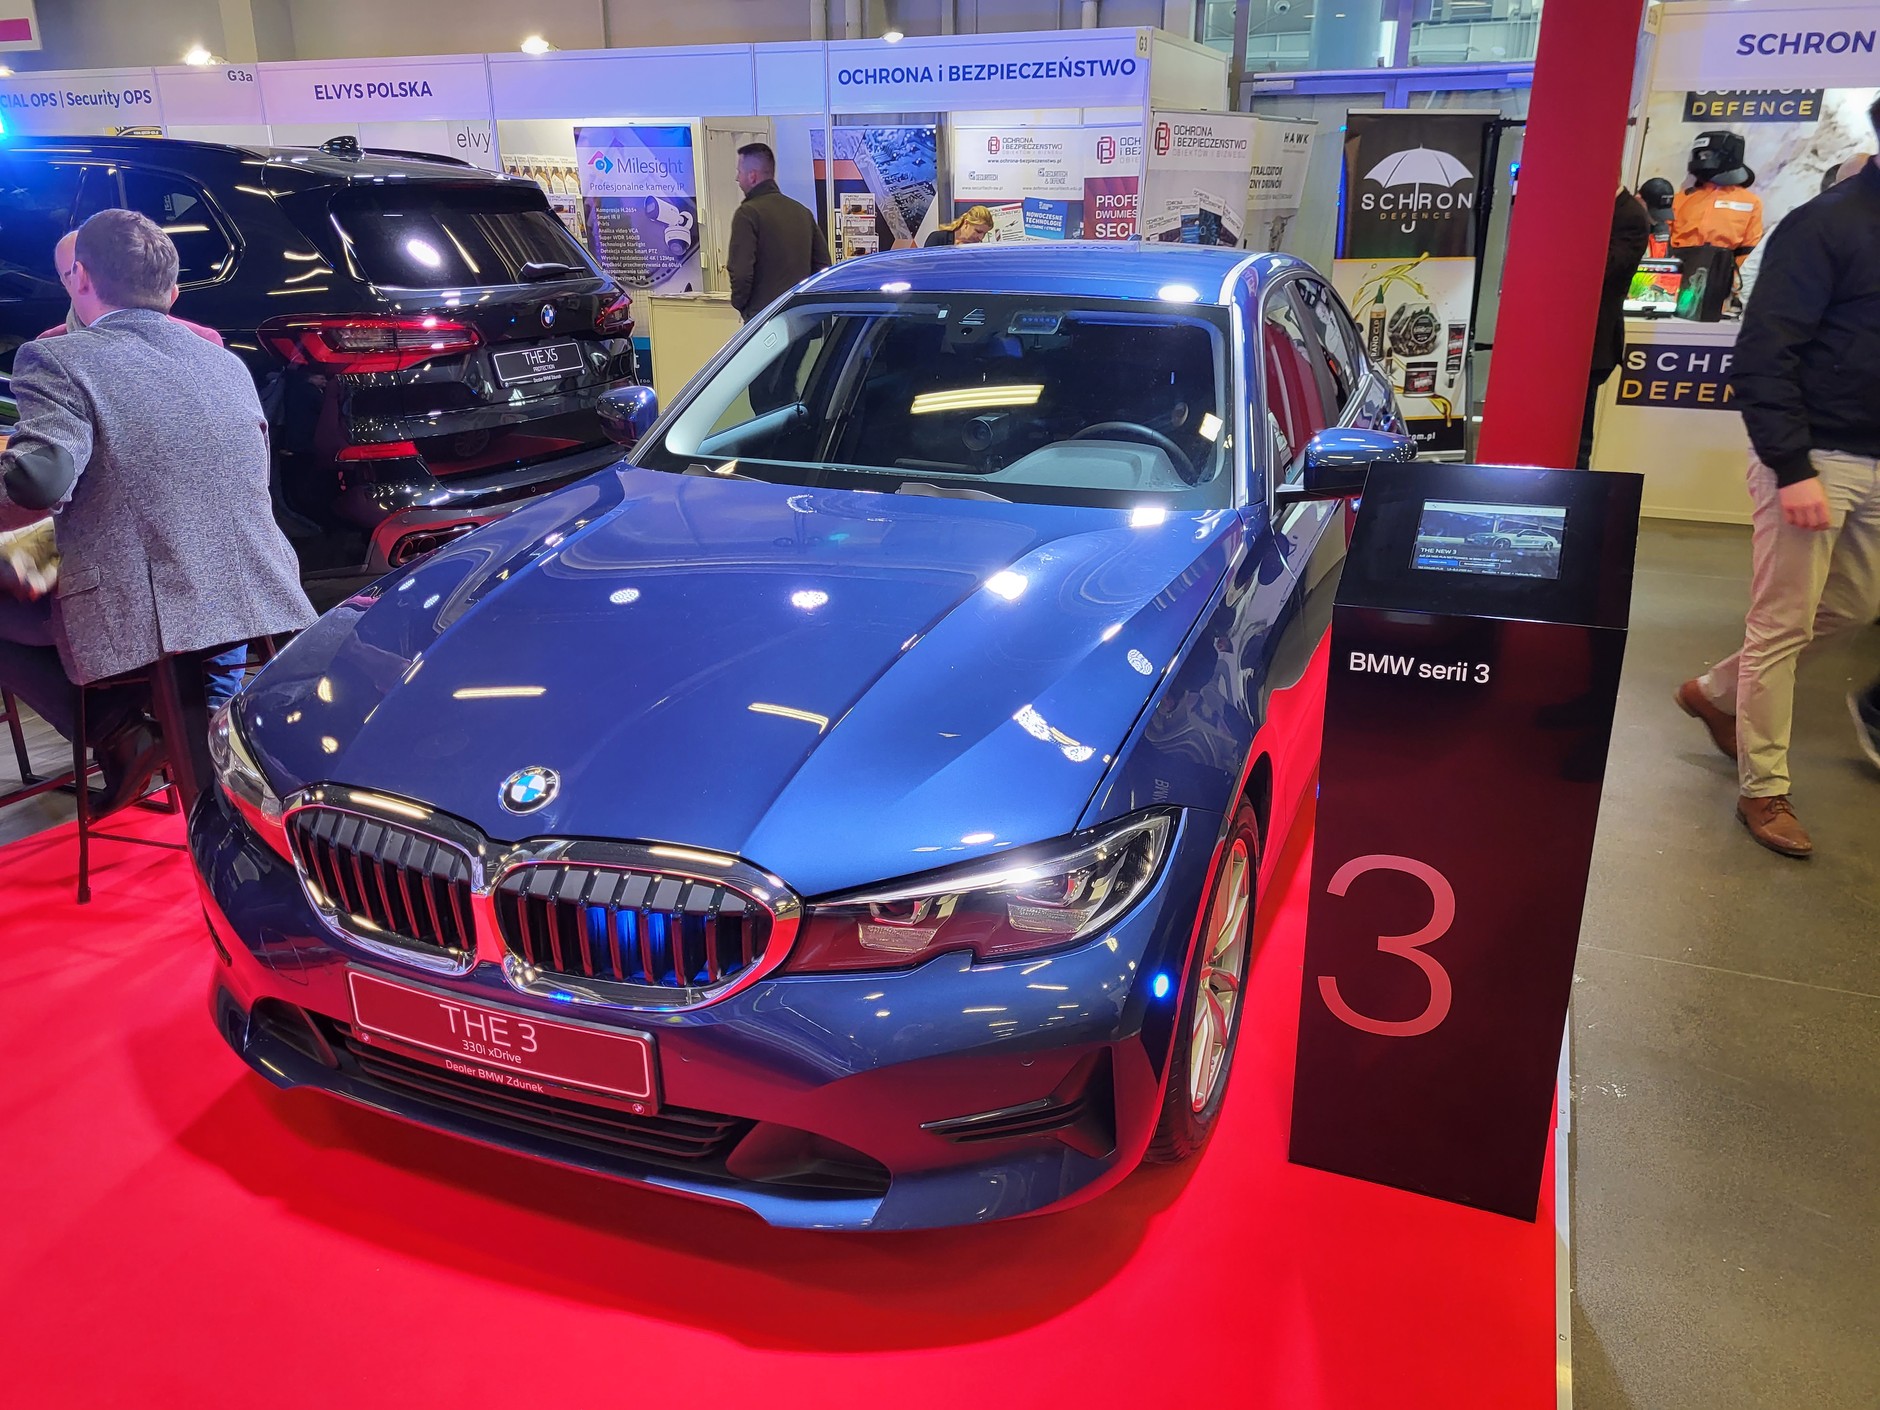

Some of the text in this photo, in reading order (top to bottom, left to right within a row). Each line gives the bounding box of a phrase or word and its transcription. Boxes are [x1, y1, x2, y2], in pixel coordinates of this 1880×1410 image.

[1138, 35, 1148, 51] G3
[1736, 30, 1876, 56] SCHRON
[227, 70, 253, 82] G3a
[837, 56, 1136, 86] OCHRONA i BEZPIECZEŃSTWO
[30, 92, 58, 107] OPS
[66, 89, 121, 109] Security
[123, 89, 152, 105] OPS
[314, 81, 433, 100] ELVYS POLSKA
[1691, 100, 1813, 116] DEFENCE
[1173, 124, 1212, 137] OCHRONA
[1283, 132, 1310, 145] HAWK
[617, 157, 684, 178] Milesight
[590, 182, 685, 192] Profesjonalne kamery IP
[1361, 193, 1473, 210] SCHRON
[1026, 211, 1063, 221] NOWOCZESNE
[1026, 217, 1062, 227] TECHNOLOGIE
[1380, 212, 1451, 220] DEFENCE
[522, 348, 559, 365] THE X5
[1349, 651, 1490, 684] BMW serii 3
[1317, 854, 1457, 1037] 3
[439, 1003, 538, 1053] THE 3
[462, 1039, 522, 1064] 330i xDrive
[445, 1059, 544, 1093] Dealer BMW Zdunek
